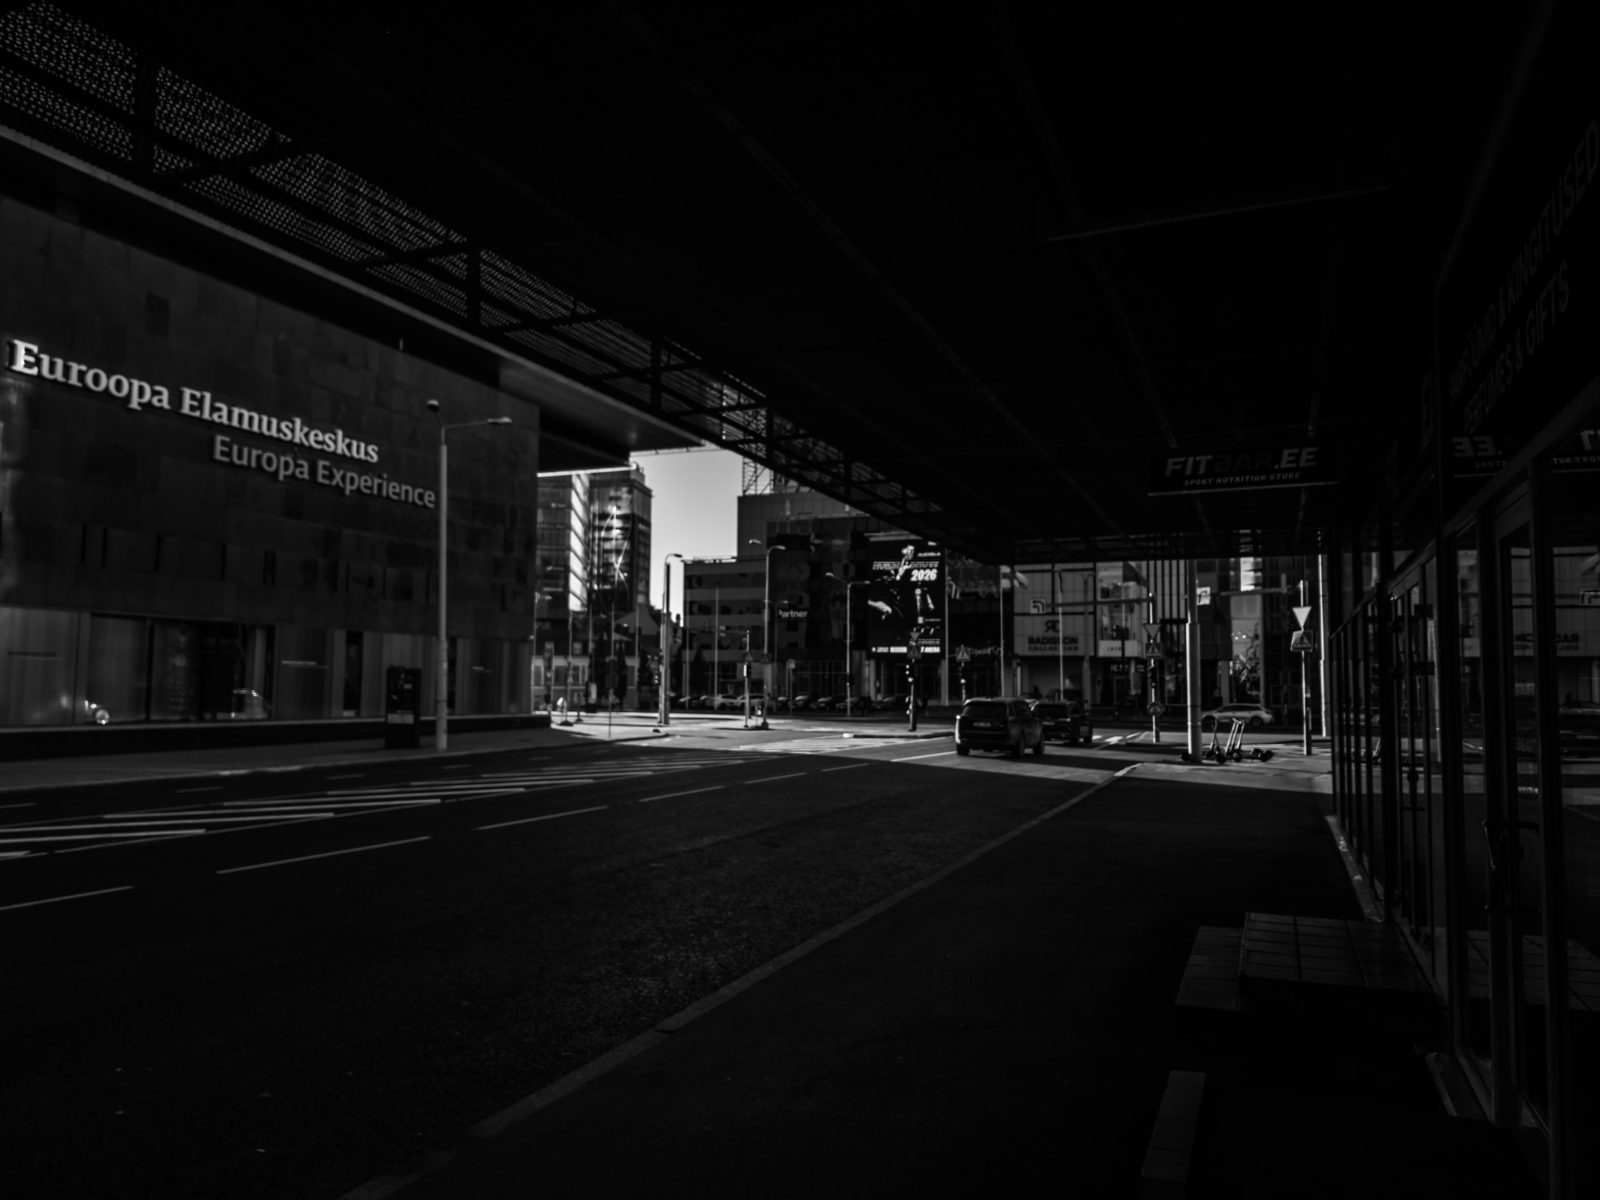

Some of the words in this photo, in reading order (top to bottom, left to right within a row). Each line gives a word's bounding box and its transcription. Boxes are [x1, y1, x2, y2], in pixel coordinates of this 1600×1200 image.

[1507, 119, 1600, 312] KINGITUSED
[1525, 257, 1570, 357] GIFTS
[9, 338, 171, 411] Euroopa
[179, 386, 379, 464] Elamuskeskus
[212, 434, 310, 482] Europa
[315, 459, 436, 509] Experience
[1164, 446, 1320, 477] FITBAR.EE
[1184, 477, 1213, 487] SPORT
[1216, 474, 1266, 485] NUTRITION
[1269, 472, 1301, 482] STORE
[910, 569, 938, 581] 2026
[1028, 636, 1078, 645] RADISON
